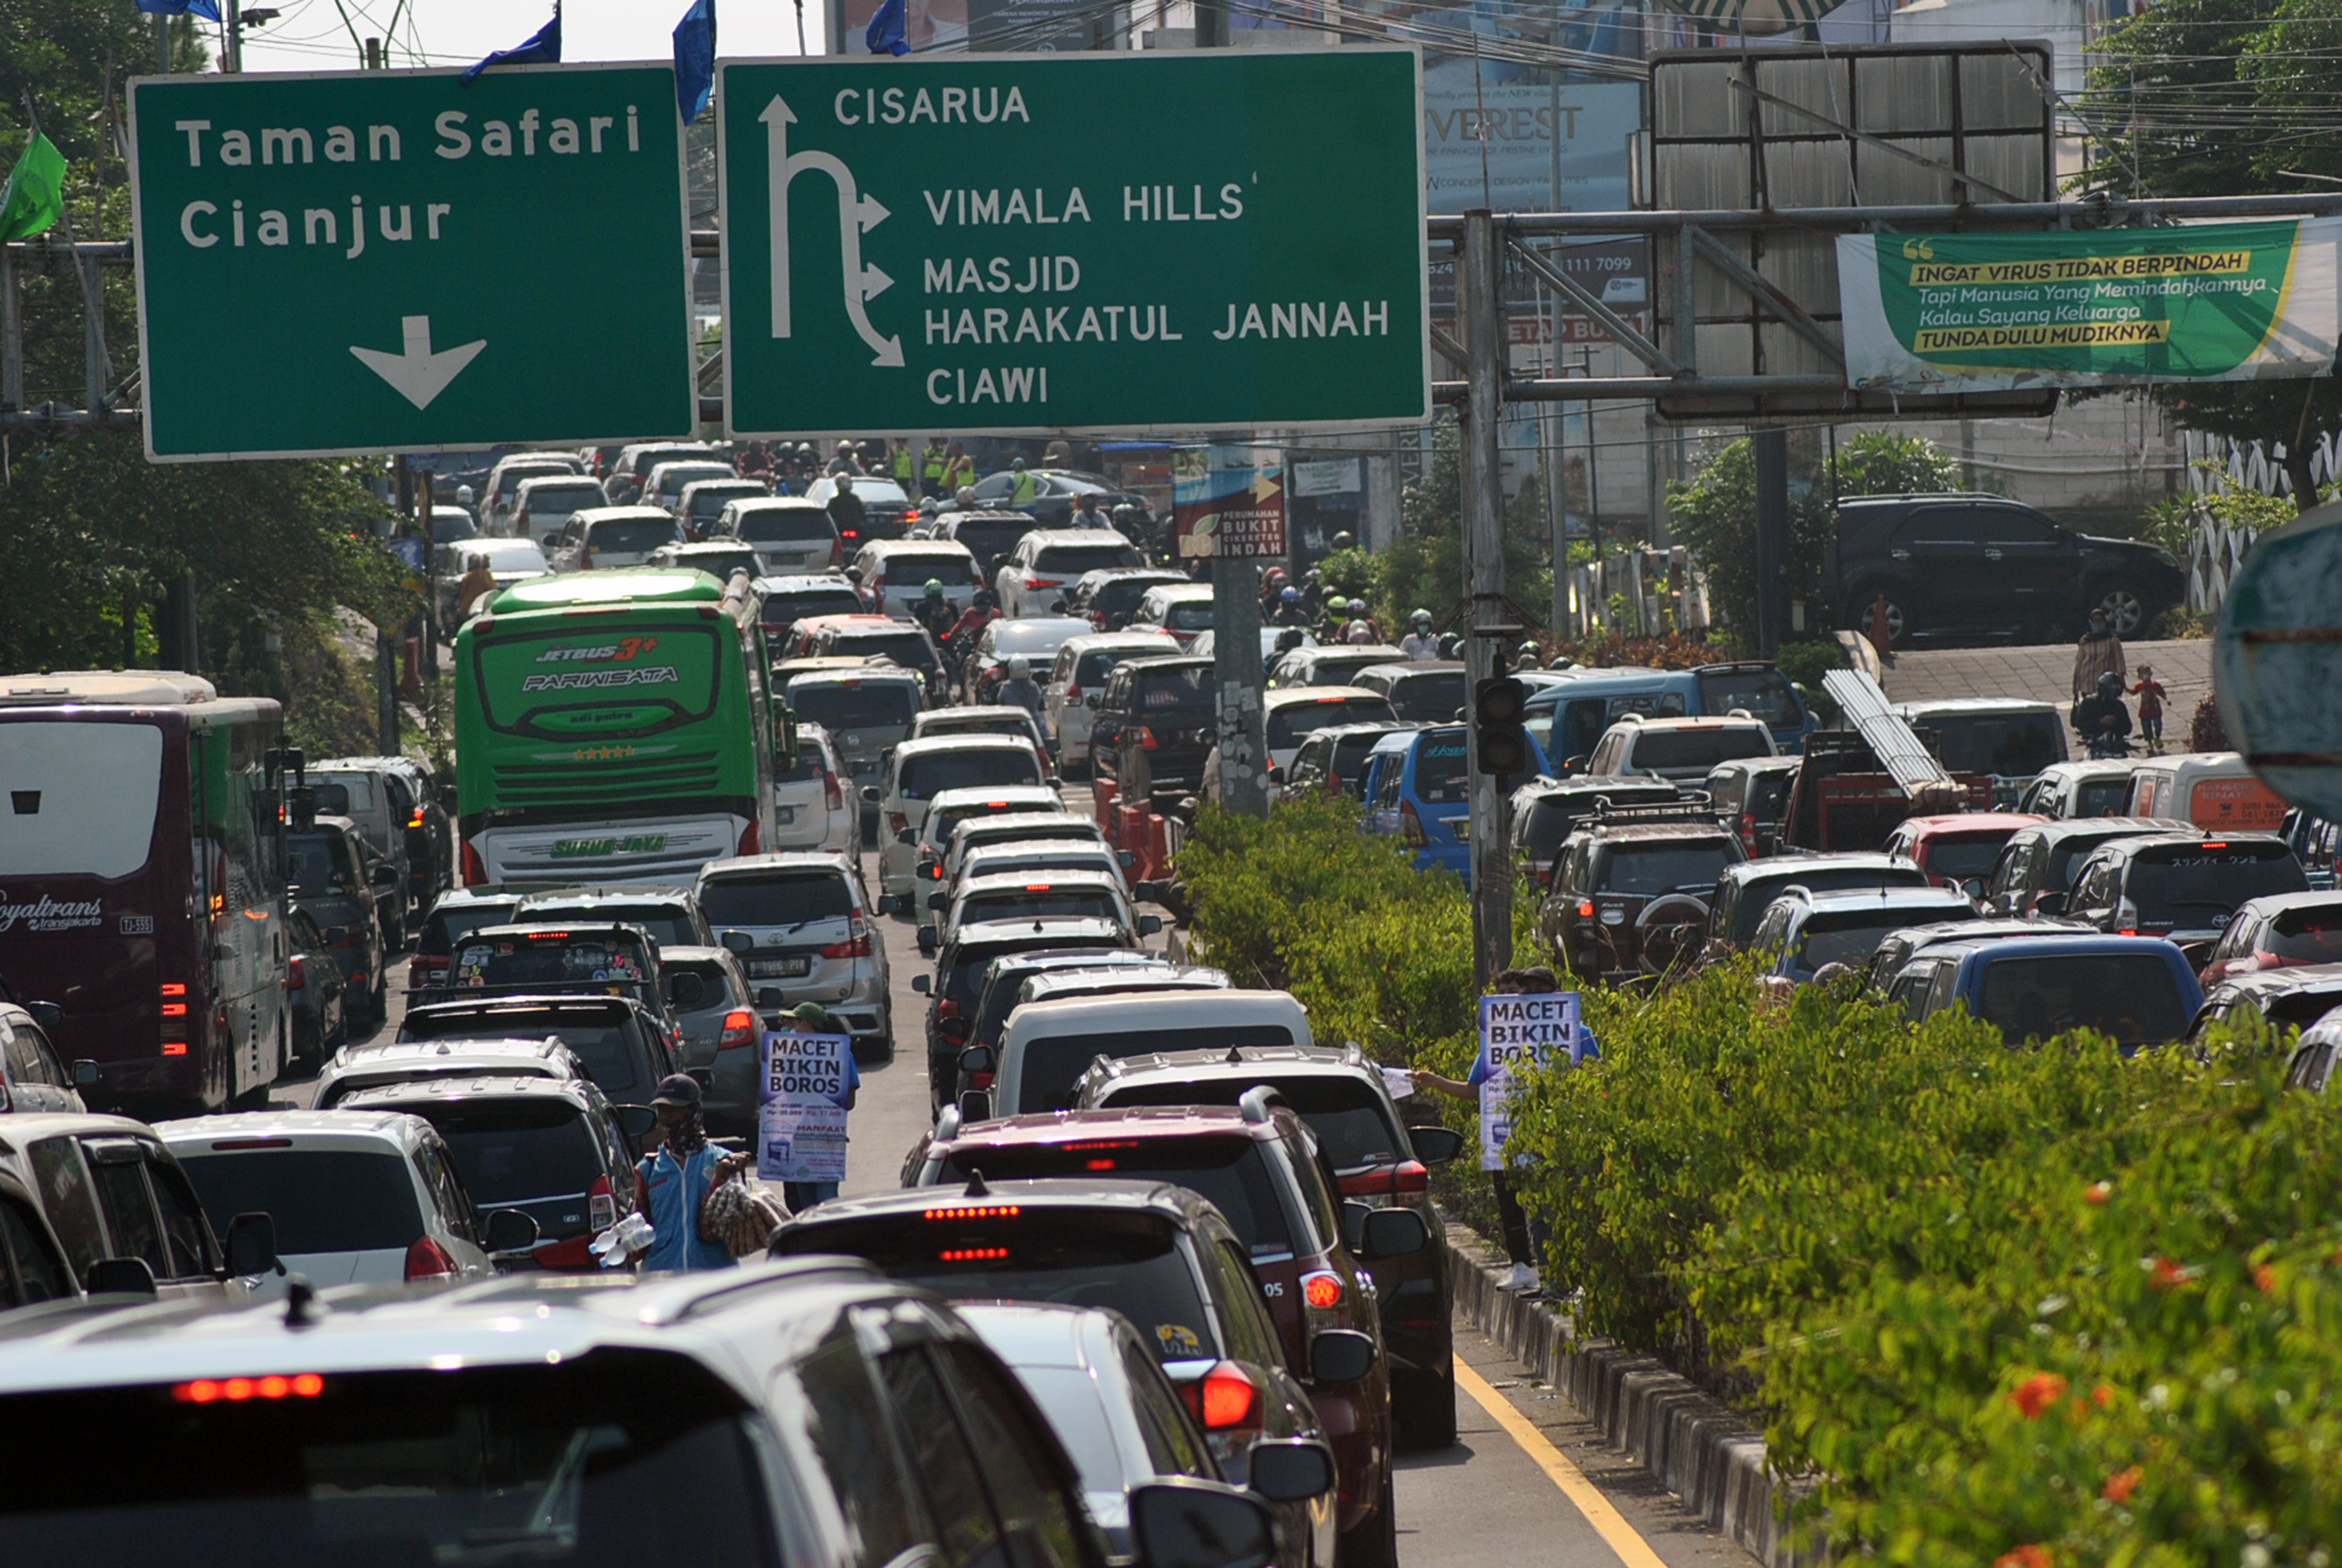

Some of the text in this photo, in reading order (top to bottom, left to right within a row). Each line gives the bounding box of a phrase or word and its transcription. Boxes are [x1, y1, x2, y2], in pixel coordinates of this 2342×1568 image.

[834, 87, 1030, 125] CISARUA
[175, 105, 639, 167] Taman Safari
[1425, 106, 1583, 141] VEREST
[923, 183, 1244, 226] VIMALA HILLS
[180, 195, 450, 259] Cianjur
[925, 256, 1080, 293] MASJID
[1596, 257, 1631, 271] 7099
[1916, 254, 2243, 282] INGAT VIRUS TIDAK BERPINDAH
[1919, 277, 2266, 307] Tapi Manusia Yang Memindahkannya
[926, 300, 1388, 344] HARAKATUL JANNAH
[1919, 305, 2140, 328] Kalau Sayang Keluarga
[1922, 324, 2160, 348] TUNDA DULU MUDIKNYA
[926, 367, 1047, 405] CIAWI
[1223, 510, 1279, 519] PERUMAHAN
[1223, 519, 1279, 533] BUKIT
[1224, 542, 1281, 556] INDAH
[522, 666, 678, 691] PARIWISATA
[550, 833, 668, 859] SUBUR JAYA
[0, 889, 102, 932] oyaltrans
[40, 916, 102, 931] transjakarta
[1491, 1001, 1569, 1022] MACET
[1491, 1023, 1570, 1044] BIKIN
[772, 1039, 840, 1056] MACET
[771, 1058, 840, 1076] BIKIN
[770, 1076, 840, 1094] BOROS
